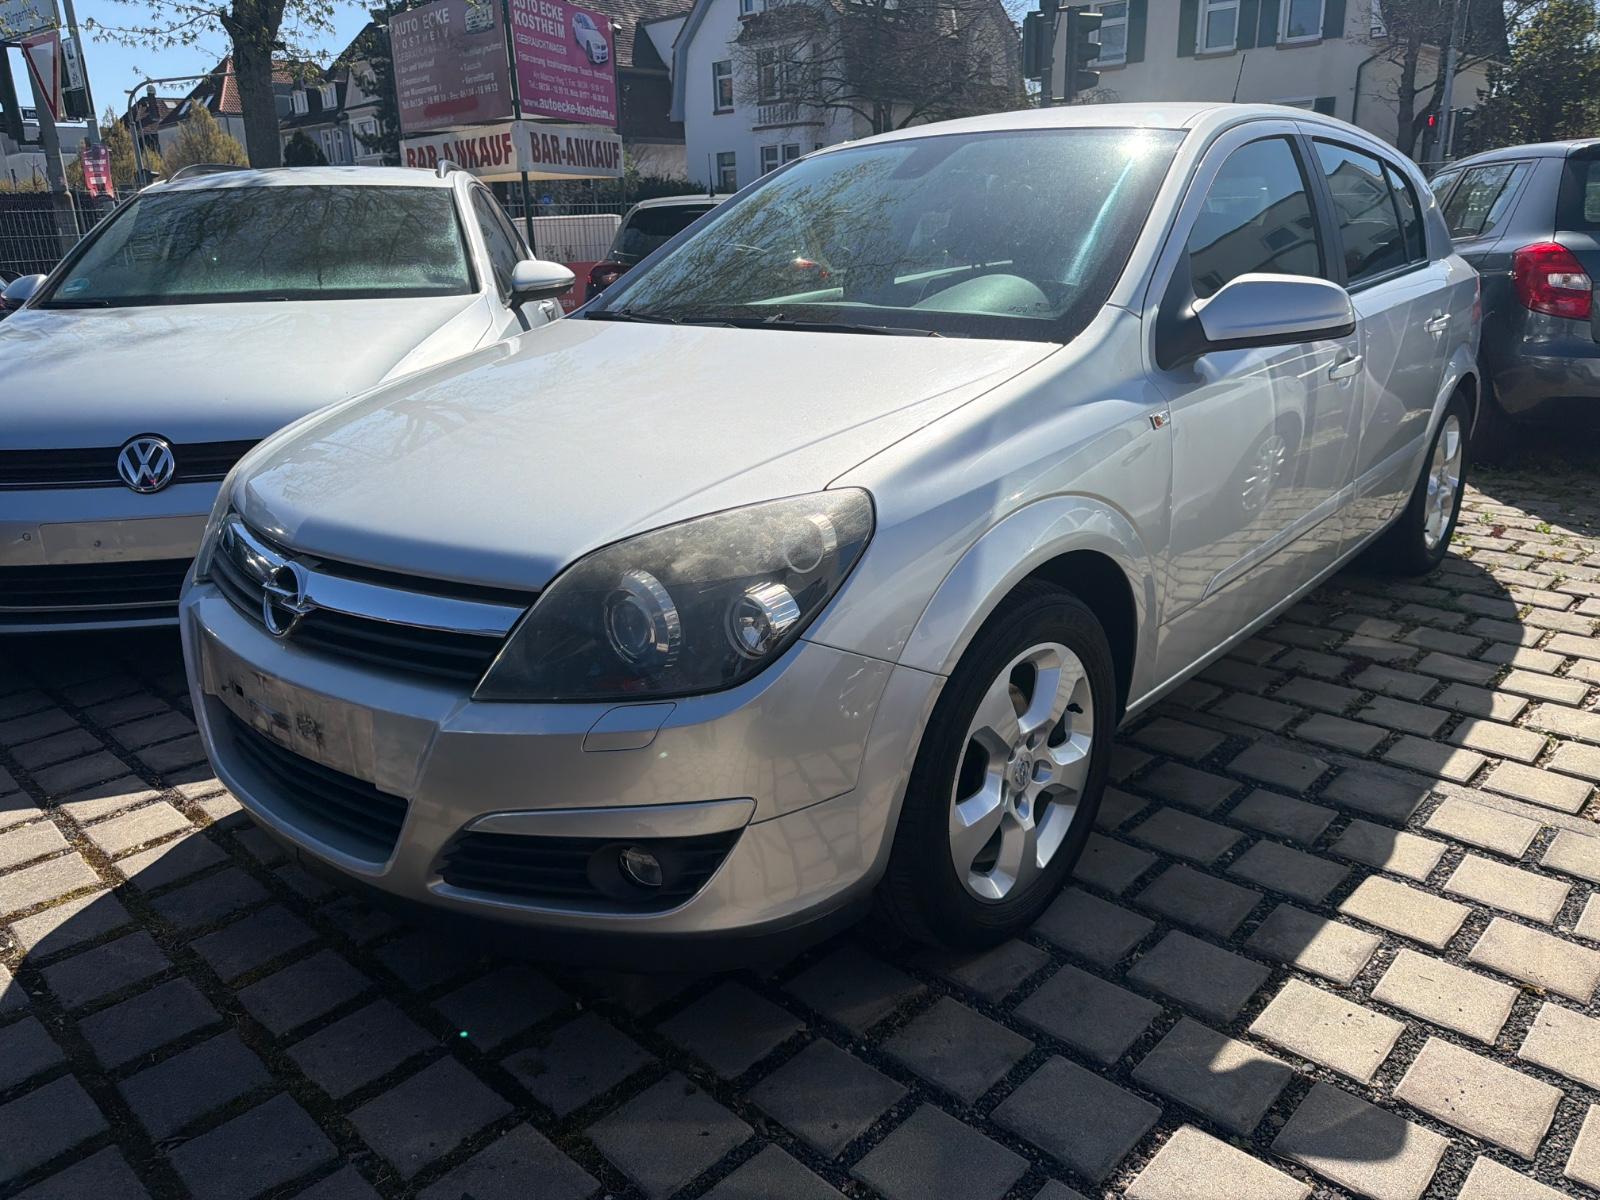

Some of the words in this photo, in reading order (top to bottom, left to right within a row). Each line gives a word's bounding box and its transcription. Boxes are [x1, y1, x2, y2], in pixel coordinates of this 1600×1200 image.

[394, 18, 418, 37] AUTO
[423, 7, 450, 30] ECKE
[513, 9, 566, 40] KOSTHEIM
[514, 0, 538, 12] AUTO
[540, 0, 564, 22] ECKE
[530, 132, 620, 170] BAR-ANKAUF
